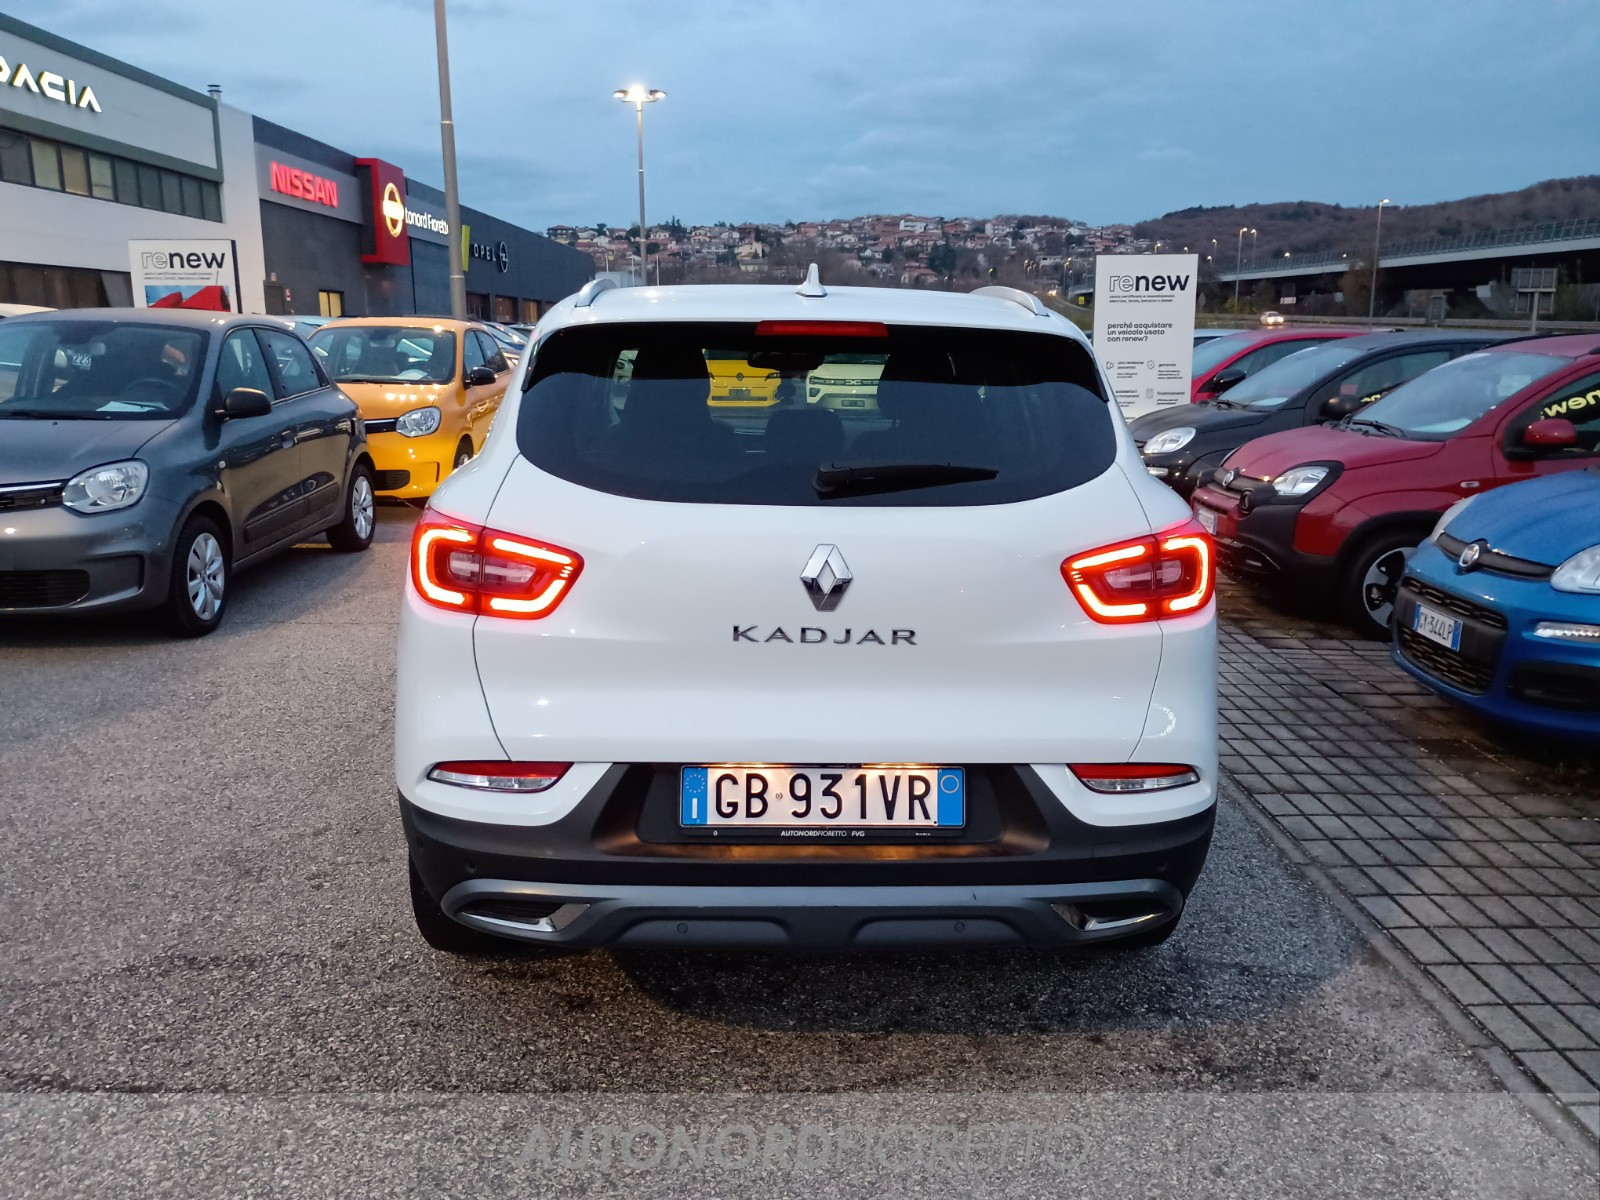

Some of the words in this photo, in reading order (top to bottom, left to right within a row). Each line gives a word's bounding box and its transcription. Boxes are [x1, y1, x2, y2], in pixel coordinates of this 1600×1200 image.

[270, 161, 338, 208] NISSAN
[141, 251, 226, 269] renew
[473, 243, 497, 262] OPEL
[1109, 275, 1190, 292] renew
[1134, 322, 1173, 330] acquistare
[732, 625, 918, 646] KADJAR
